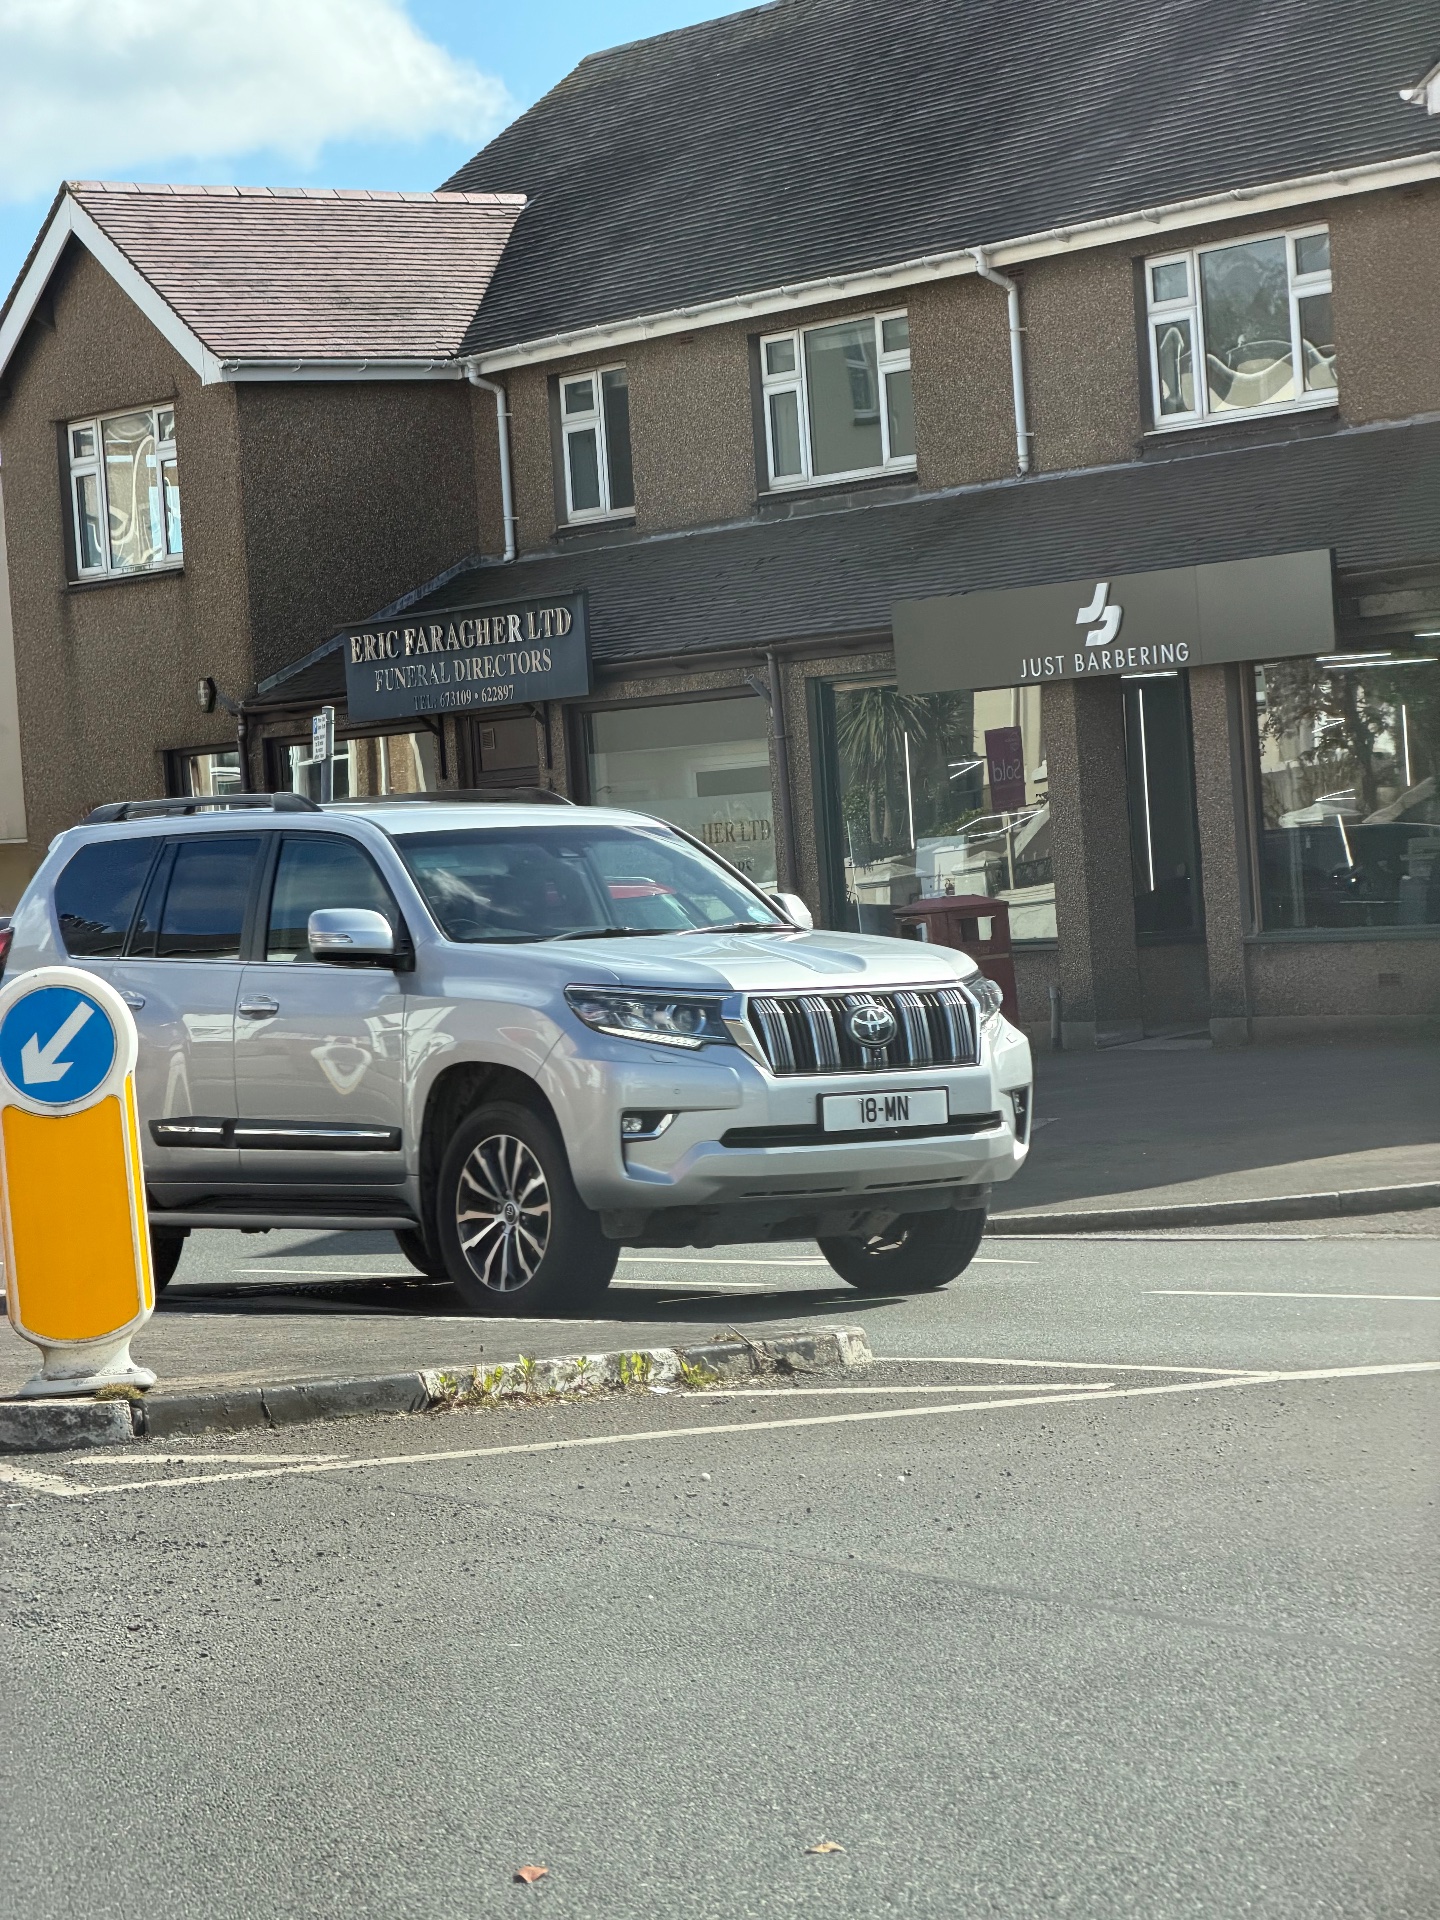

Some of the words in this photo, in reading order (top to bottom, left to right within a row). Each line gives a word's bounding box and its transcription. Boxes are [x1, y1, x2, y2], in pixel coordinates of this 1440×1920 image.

[350, 630, 400, 664] ERIC
[404, 614, 523, 656] FARAGHER
[526, 607, 571, 640] LTD
[374, 661, 451, 692] FUNERAL
[453, 648, 552, 683] DIRECTORS
[1020, 654, 1065, 678] JUST
[1074, 642, 1190, 672] BARBERING
[440, 690, 471, 707] 673109
[481, 684, 514, 703] 622897
[741, 819, 771, 841] LTD
[860, 1095, 910, 1123] 18-MN
